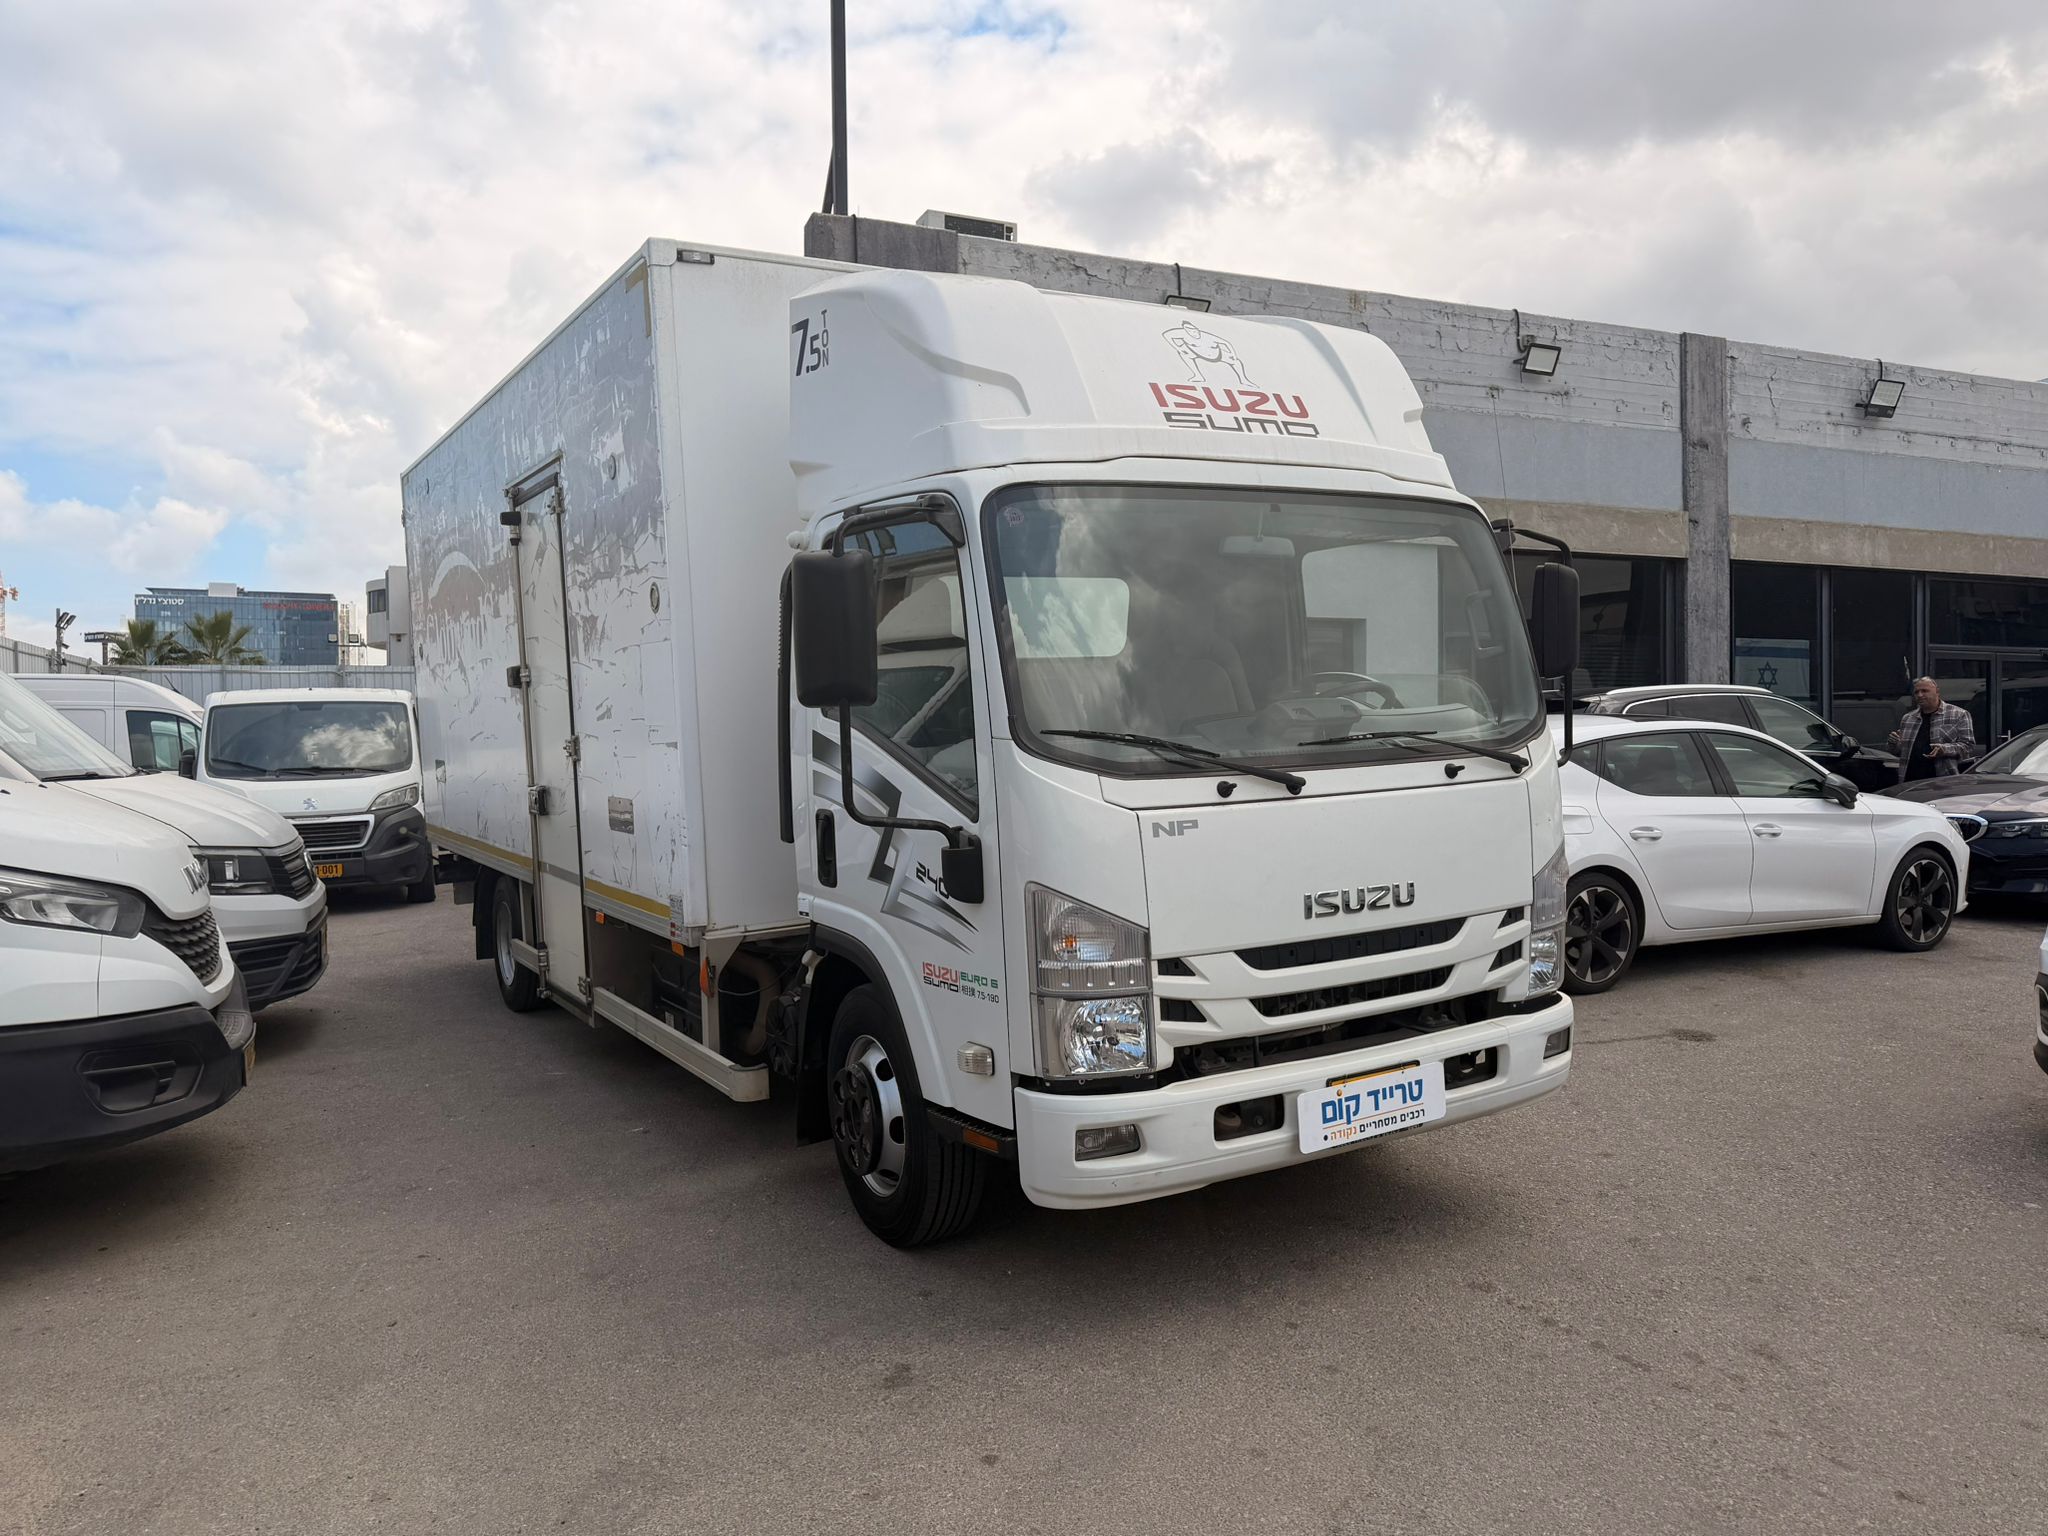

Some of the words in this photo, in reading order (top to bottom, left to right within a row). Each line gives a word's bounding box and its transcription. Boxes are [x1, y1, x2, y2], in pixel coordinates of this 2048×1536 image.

[792, 317, 821, 376] 7.5
[821, 309, 829, 367] TON
[1148, 382, 1310, 419] ISUZU
[1163, 411, 1320, 438] SUMO
[1152, 819, 1199, 838] NP
[1303, 881, 1415, 920] ISUZU
[922, 961, 958, 983] ISUZU
[960, 971, 988, 987] EURO
[990, 978, 999, 989] 6
[923, 976, 959, 993] SUMO
[1367, 1078, 1424, 1111] טרייד
[1359, 1115, 1397, 1133] מסחריים
[1400, 1108, 1425, 1122] רכבים
